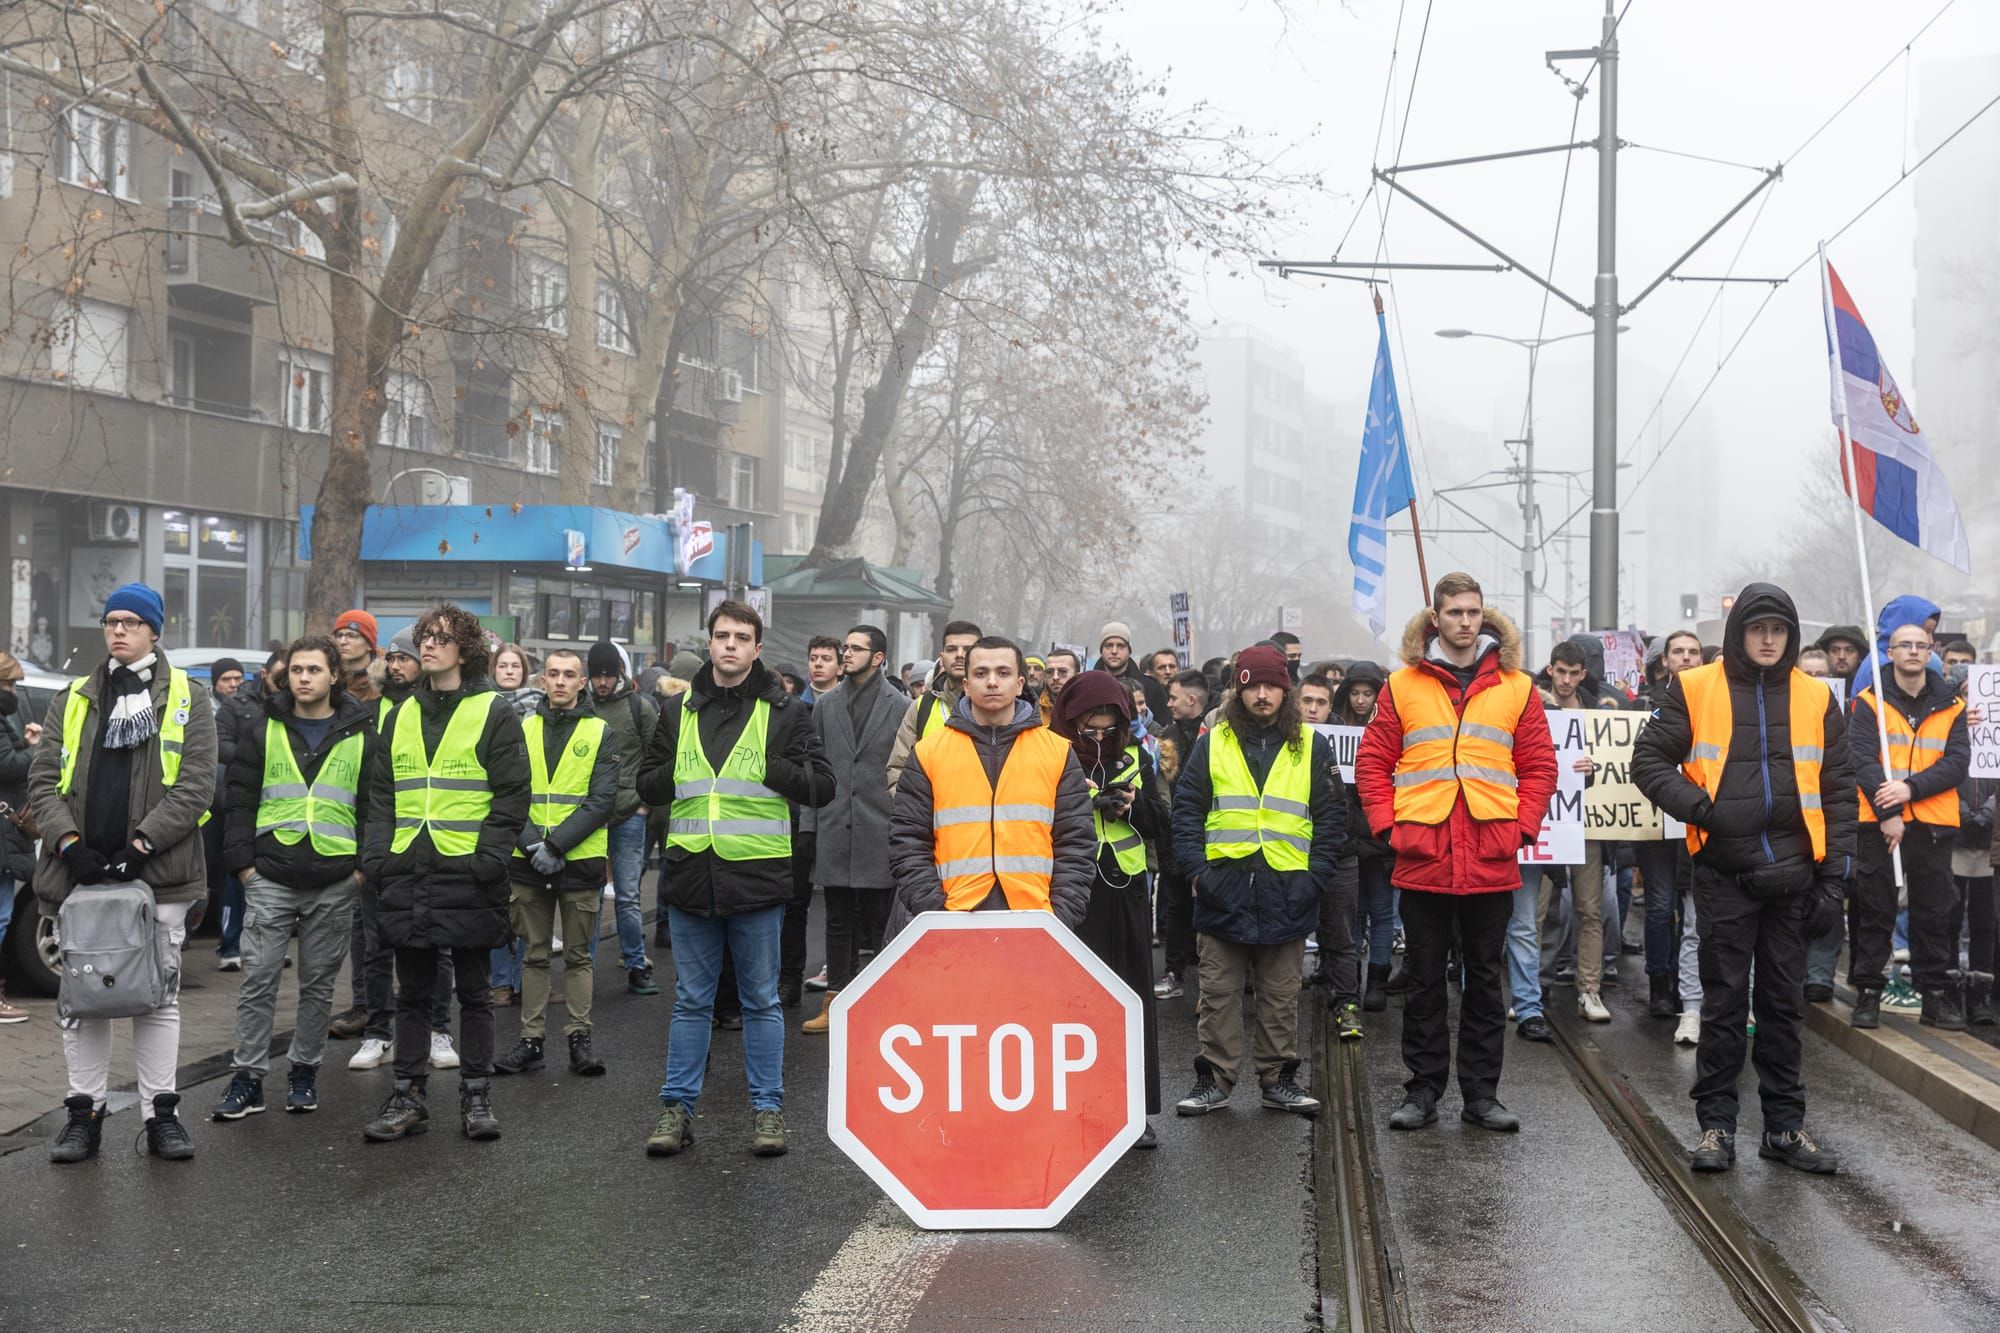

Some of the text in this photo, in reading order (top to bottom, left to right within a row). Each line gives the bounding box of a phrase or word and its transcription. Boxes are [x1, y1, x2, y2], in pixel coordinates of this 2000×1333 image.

[326, 756, 359, 783] FPN
[441, 759, 468, 777] FPN
[728, 745, 765, 774] FPN
[1584, 803, 1643, 828] ЊУЈЕ
[878, 1022, 1098, 1114] STOP
